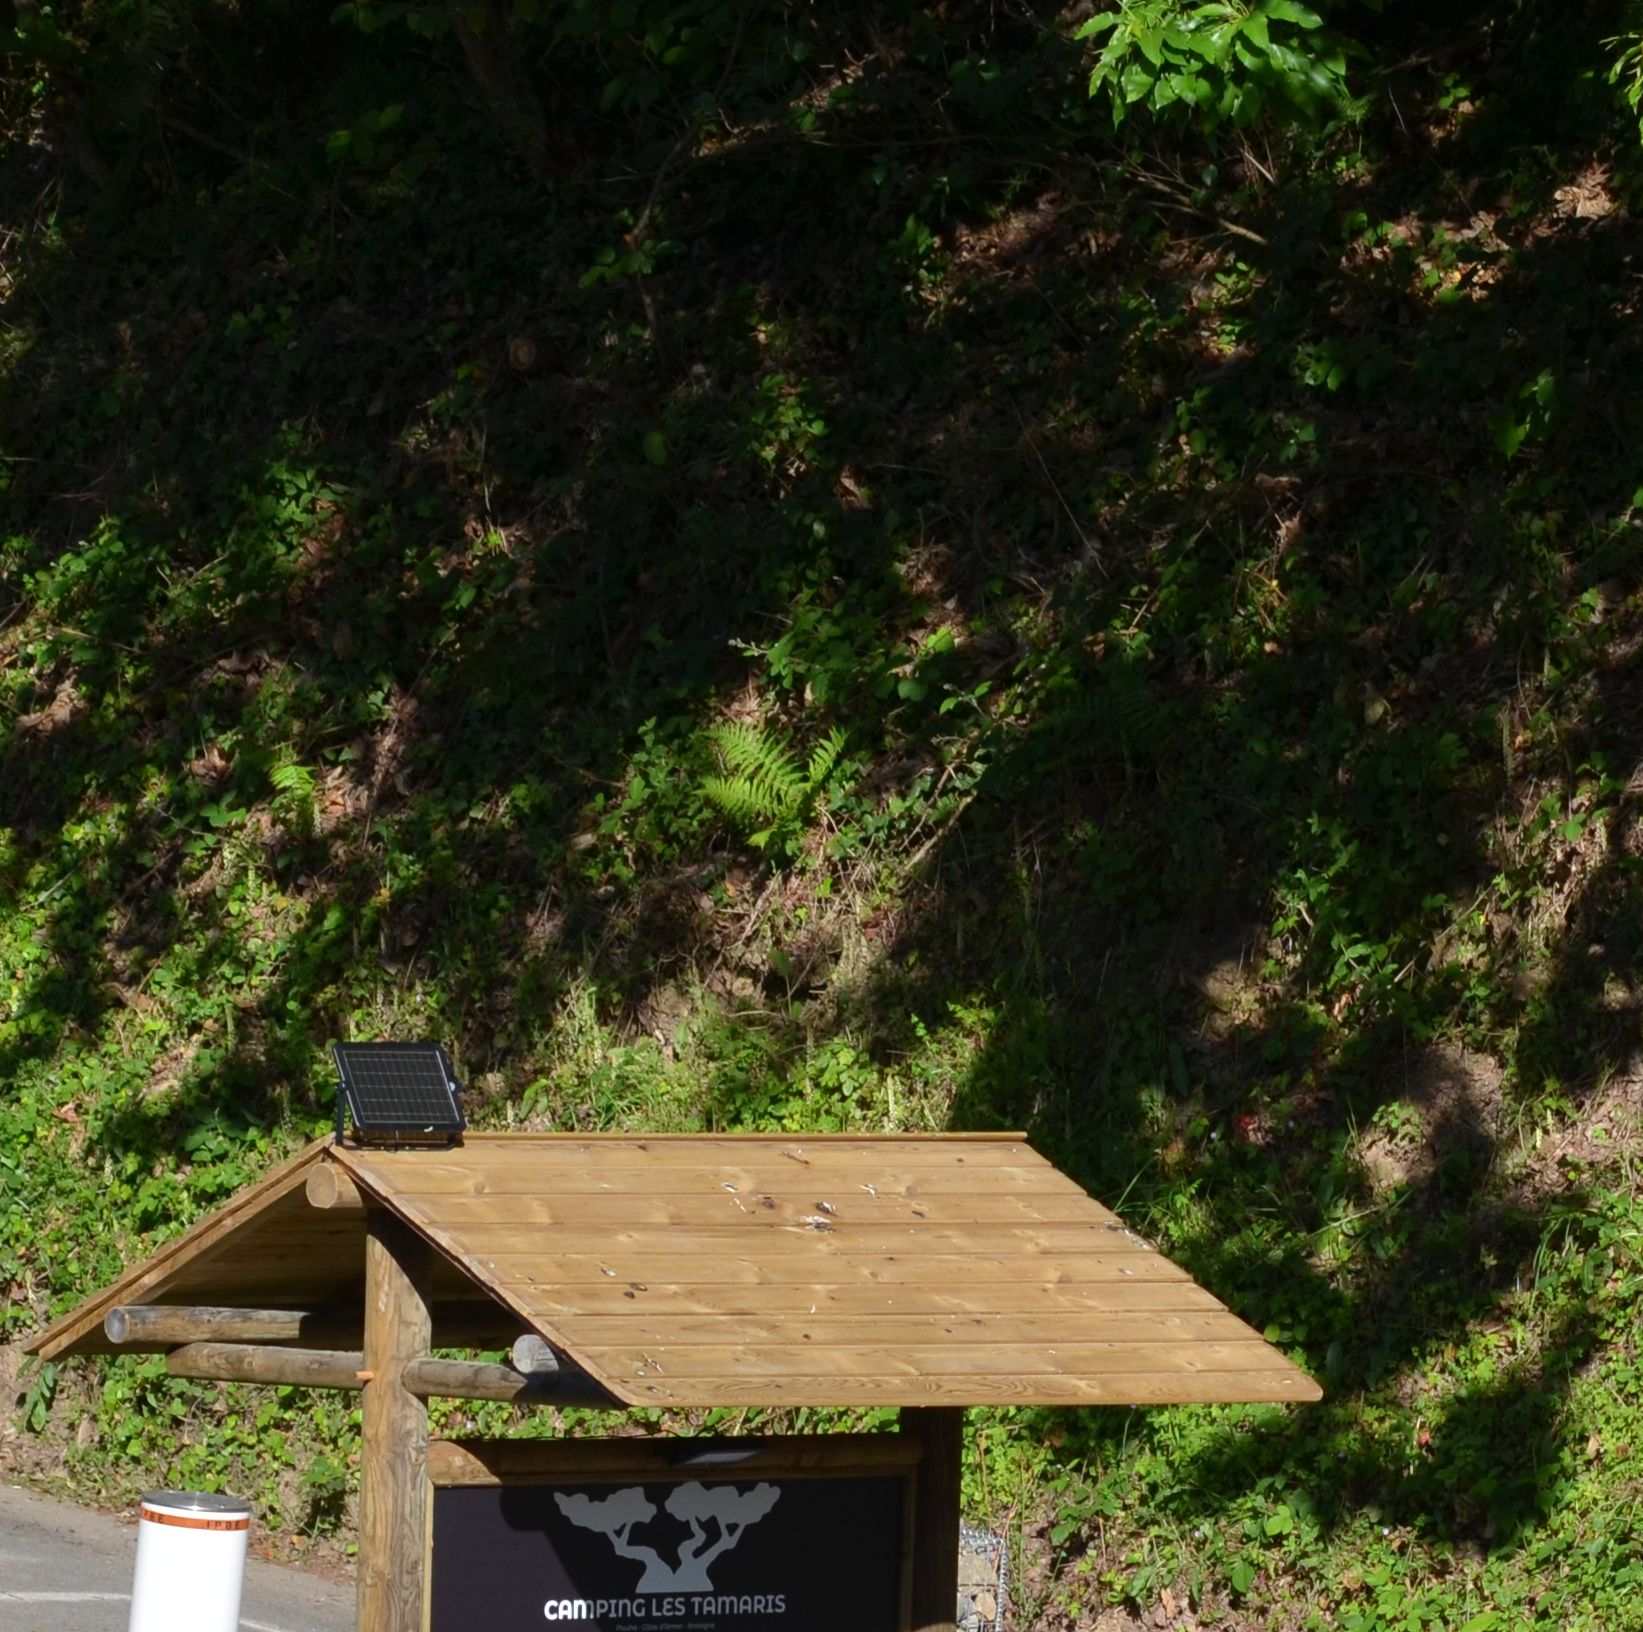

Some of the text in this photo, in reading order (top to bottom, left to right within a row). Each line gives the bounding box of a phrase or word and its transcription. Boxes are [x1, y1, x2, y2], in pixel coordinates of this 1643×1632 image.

[544, 1595, 785, 1620] CAMPING LES TAMARIS
